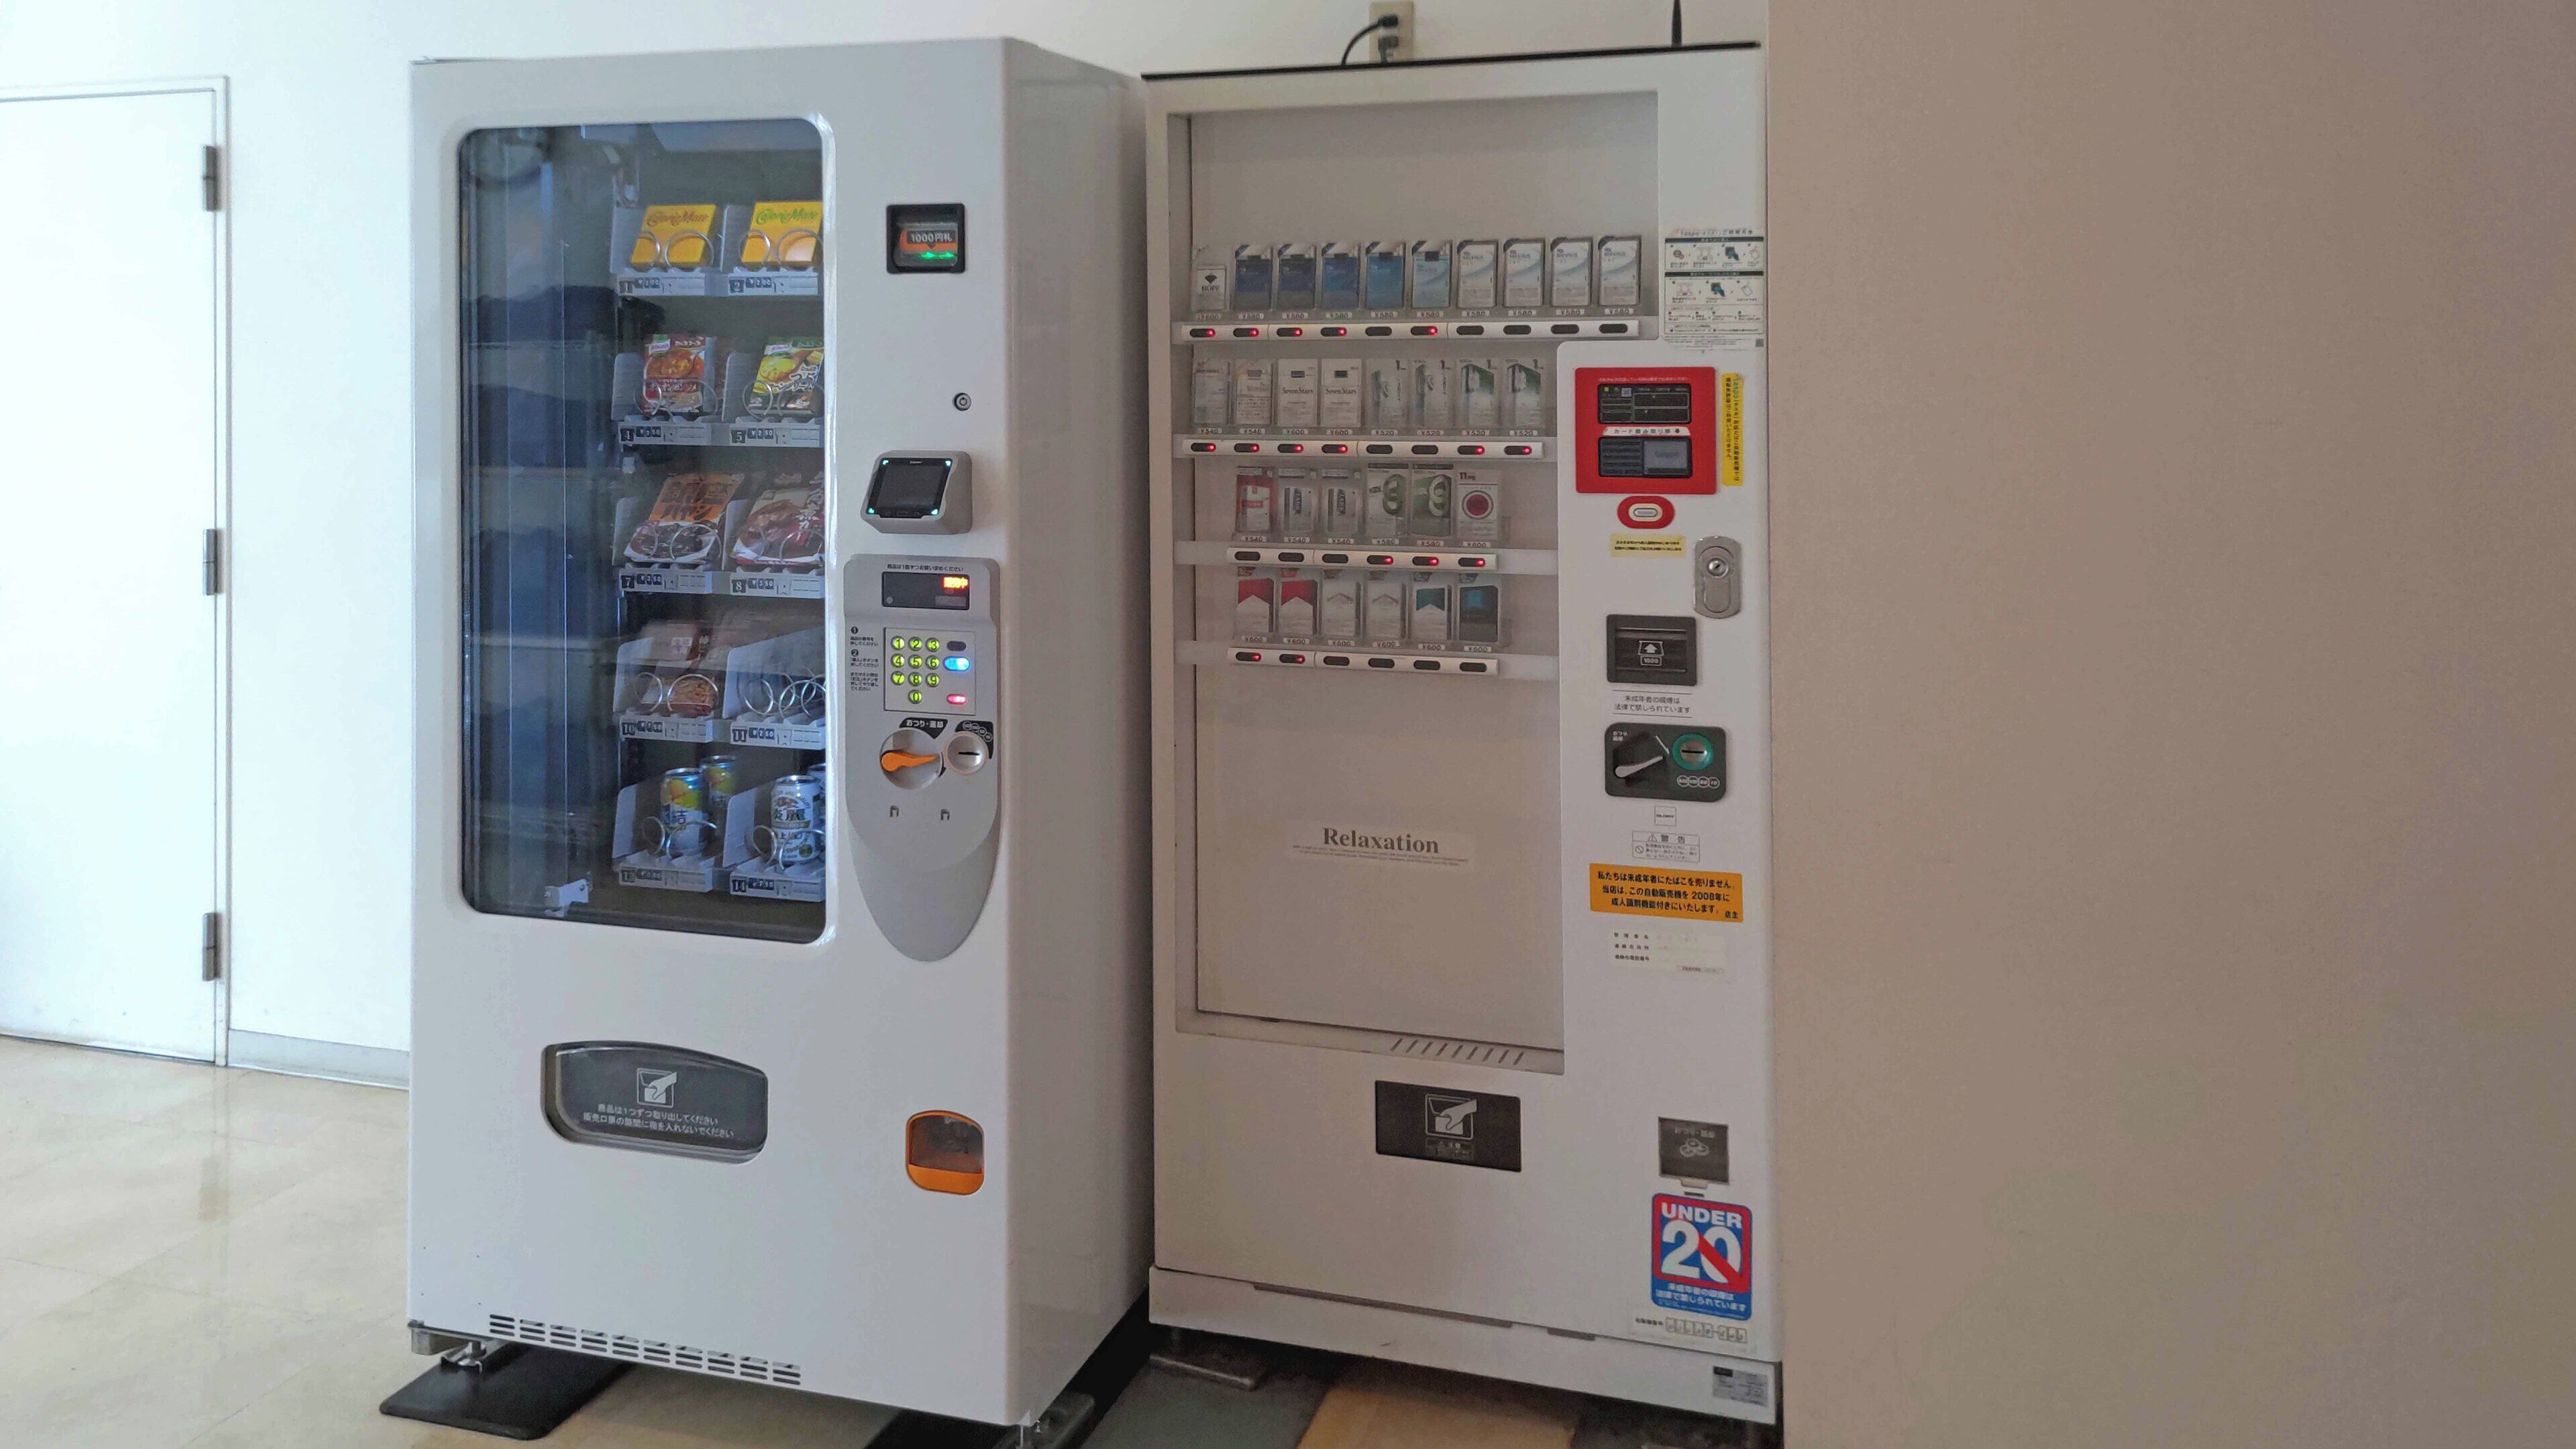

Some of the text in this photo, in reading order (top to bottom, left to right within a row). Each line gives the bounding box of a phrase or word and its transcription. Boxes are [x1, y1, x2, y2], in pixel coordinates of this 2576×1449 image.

[733, 282, 741, 292] 2
[736, 431, 743, 441] 5
[625, 577, 631, 586] 7
[736, 581, 743, 590] 8
[896, 639, 937, 649] 1 2 3
[895, 656, 936, 667] 4 5 6
[896, 674, 936, 685] 7 8 9
[913, 692, 919, 702] 0
[1323, 827, 1439, 853] Relaxation
[598, 1104, 718, 1125] 商品は1つずつ取り出してください
[1661, 1202, 1743, 1229] UNDER
[1661, 1220, 1741, 1283] 20
